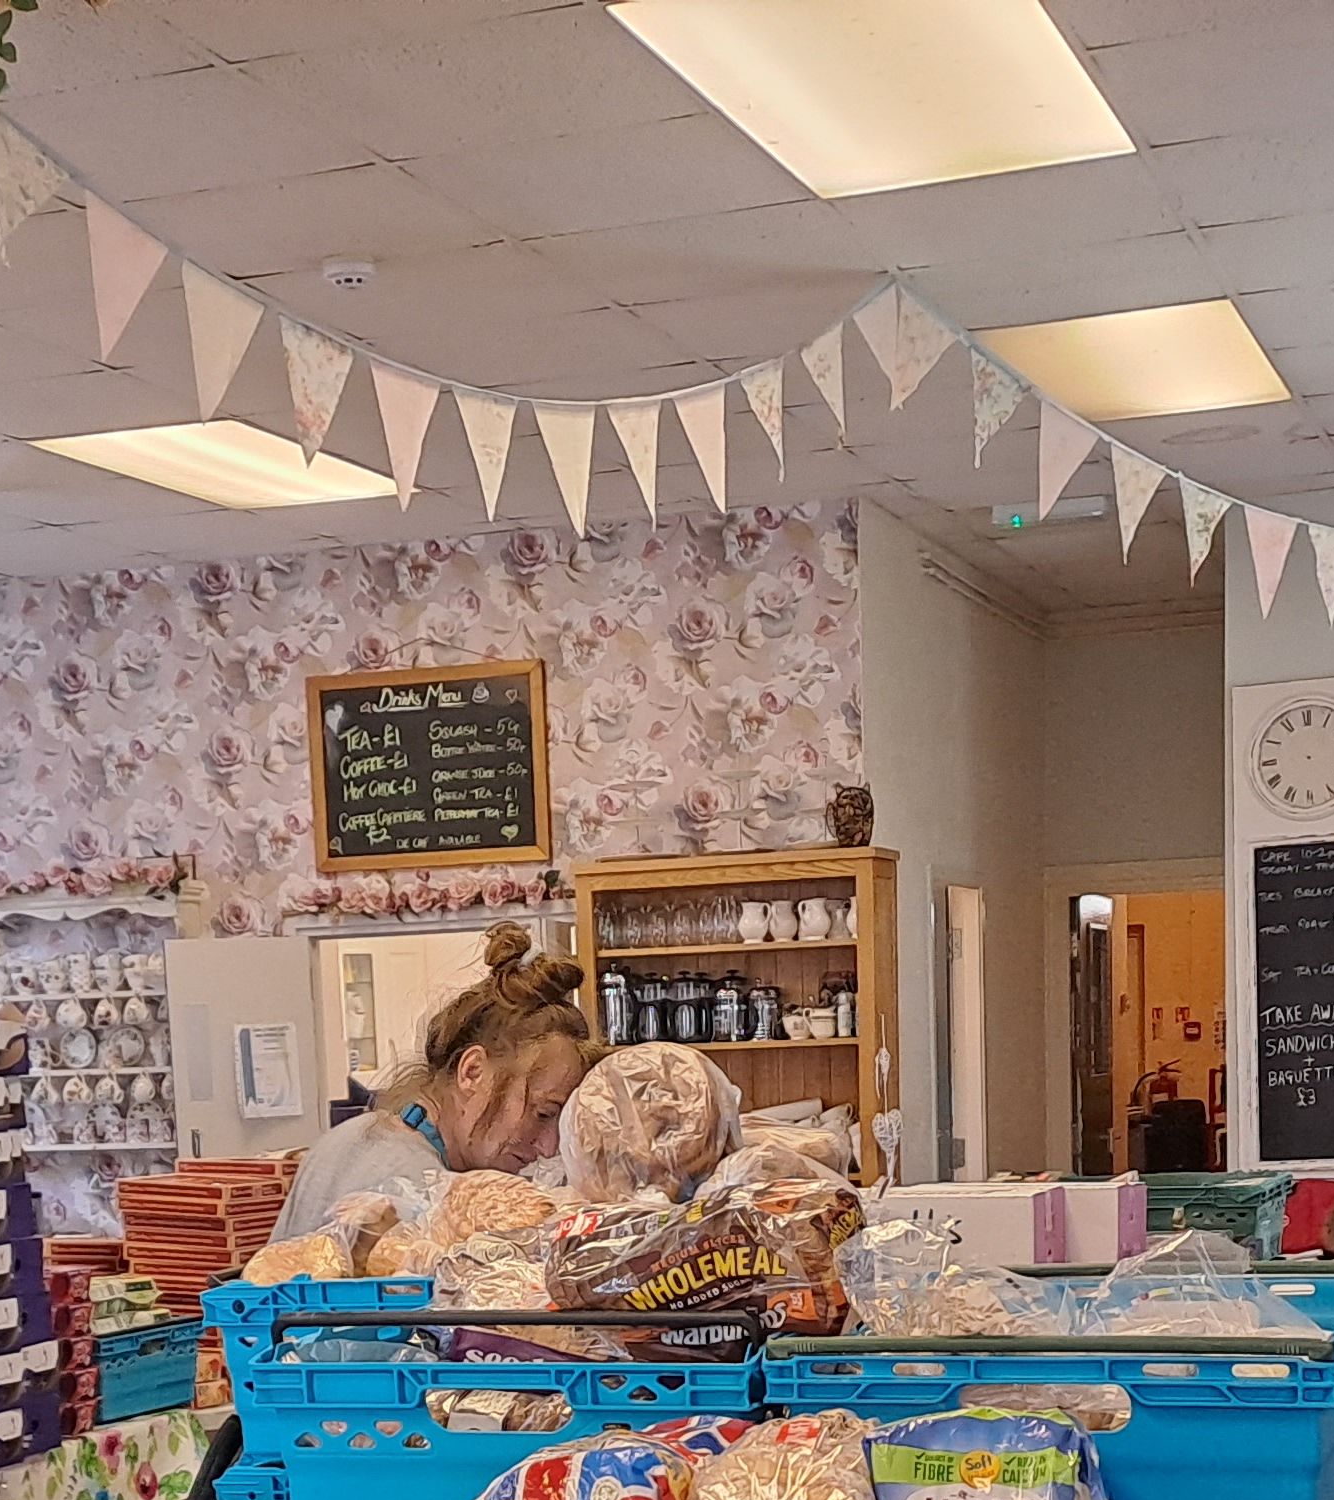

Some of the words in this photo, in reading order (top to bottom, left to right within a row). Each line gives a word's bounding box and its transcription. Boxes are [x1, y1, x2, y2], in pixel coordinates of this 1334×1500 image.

[374, 687, 421, 711] Drinks
[425, 683, 462, 707] Menu
[506, 762, 528, 776] 50p
[432, 787, 467, 803] GREEN
[470, 787, 493, 800] TEA
[505, 787, 518, 800] £1
[506, 803, 519, 817] £1
[339, 811, 376, 832] COFFEE
[366, 826, 391, 846] £2
[1261, 851, 1291, 863] CAFE
[1260, 1005, 1302, 1024] TAKE
[1296, 1087, 1316, 1106] £3
[703, 1232, 747, 1252] SLICED
[624, 1246, 787, 1311] WHOLEMEAL
[669, 1299, 685, 1311] NO
[687, 1288, 720, 1308] ADDED
[914, 1462, 954, 1482] FIBRE
[965, 1455, 992, 1471] Soft
